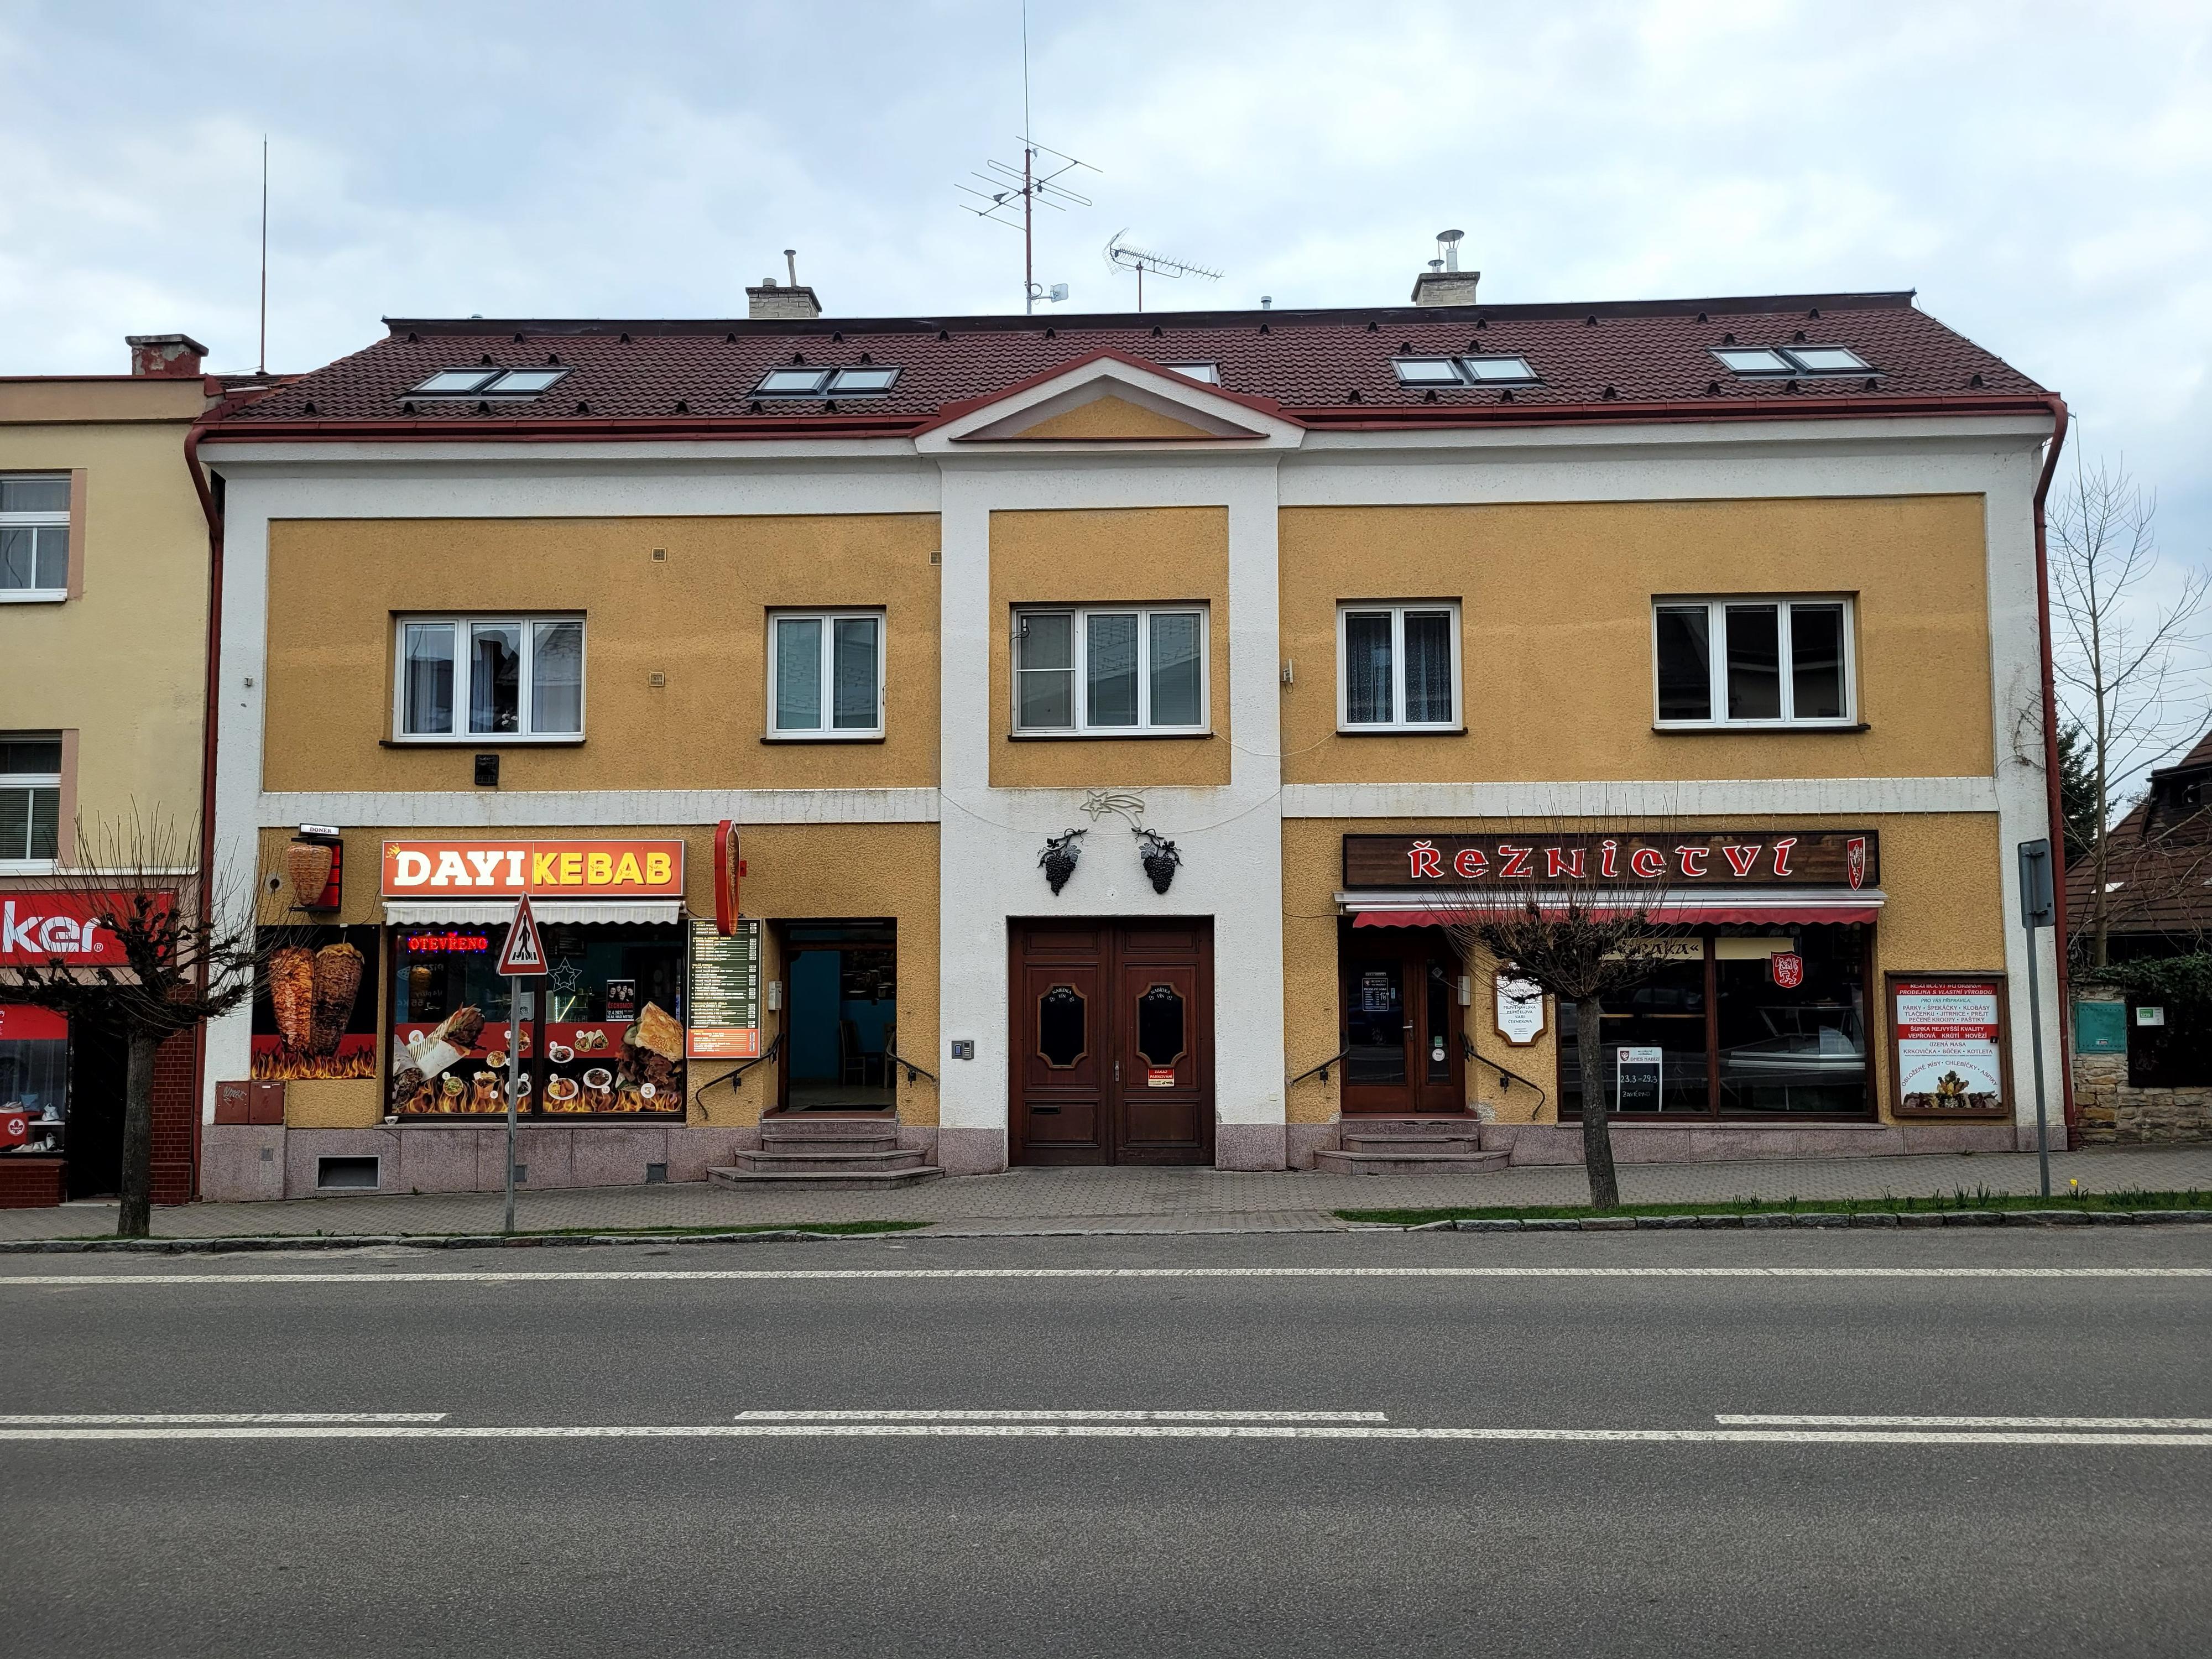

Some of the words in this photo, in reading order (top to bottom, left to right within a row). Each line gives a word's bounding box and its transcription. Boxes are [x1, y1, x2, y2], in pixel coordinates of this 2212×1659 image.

[394, 851, 525, 886] DAYI
[533, 852, 672, 885] KEBAB
[408, 932, 488, 951] OTEVŘENO
[1151, 987, 1170, 995] NABÍDKA
[1901, 1064, 1927, 1087] OBLOŽENÉ
[1927, 1060, 1941, 1068] MÍSY
[1945, 1060, 1978, 1071] CHLEBÍČKY
[1980, 1070, 1998, 1086] ASPIKY
[644, 1087, 651, 1095] 3
